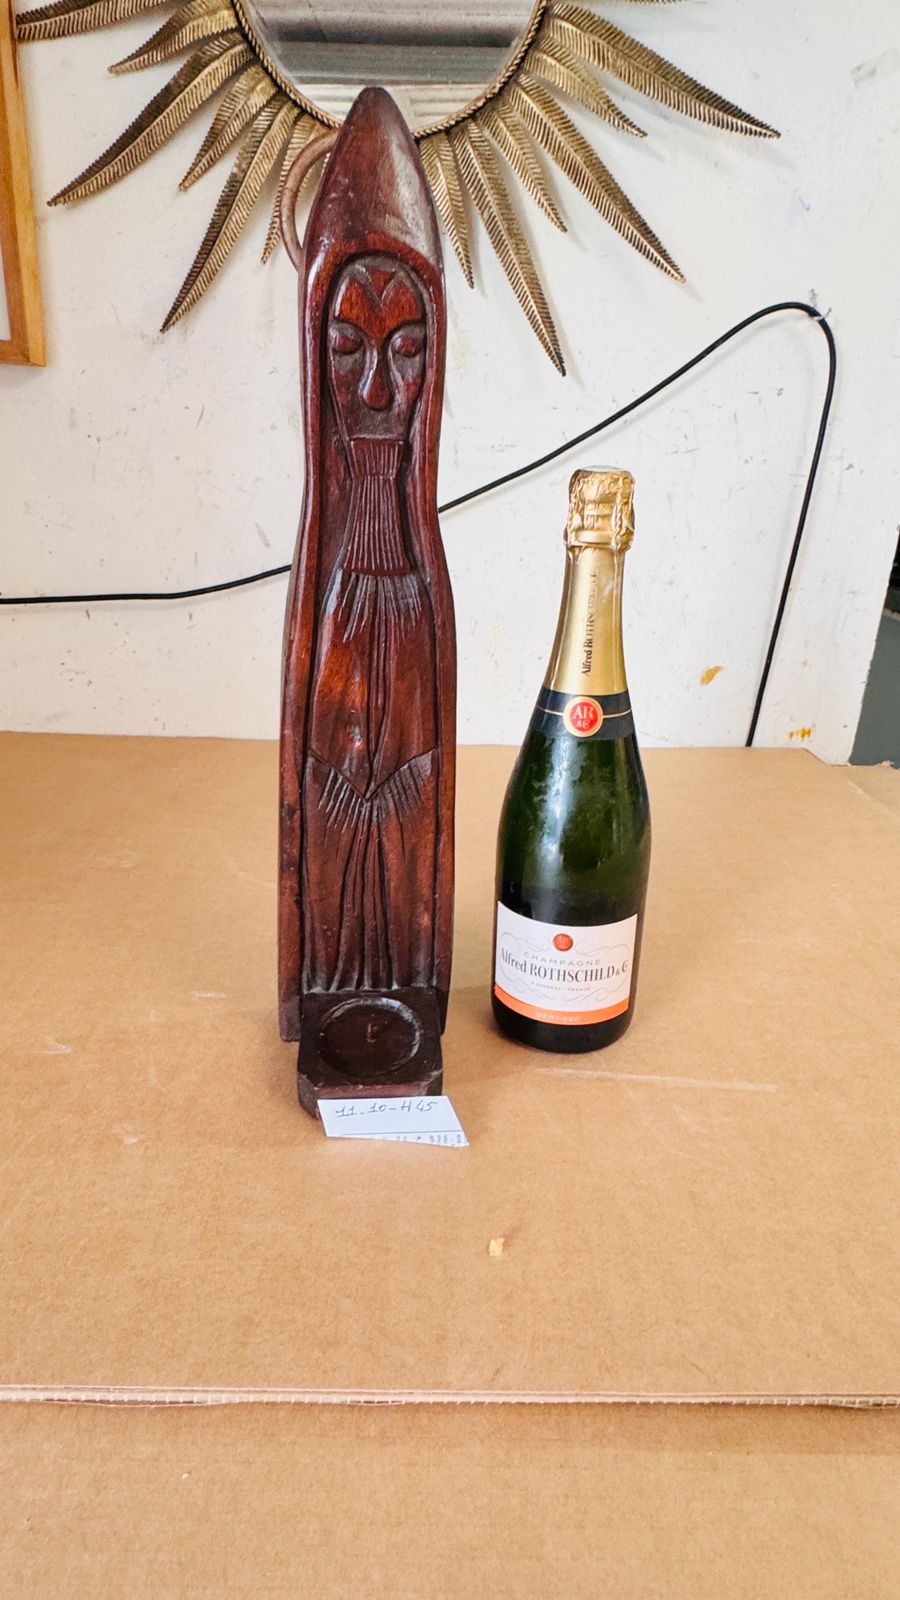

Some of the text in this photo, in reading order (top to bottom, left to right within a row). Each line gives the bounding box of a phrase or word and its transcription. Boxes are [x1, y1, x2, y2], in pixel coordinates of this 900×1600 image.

[581, 650, 593, 676] Alfred
[573, 706, 594, 720] AR
[500, 948, 527, 973] Alfred
[530, 963, 615, 983] ROTHSCHILD
[524, 952, 602, 967] CHAMPAGNE
